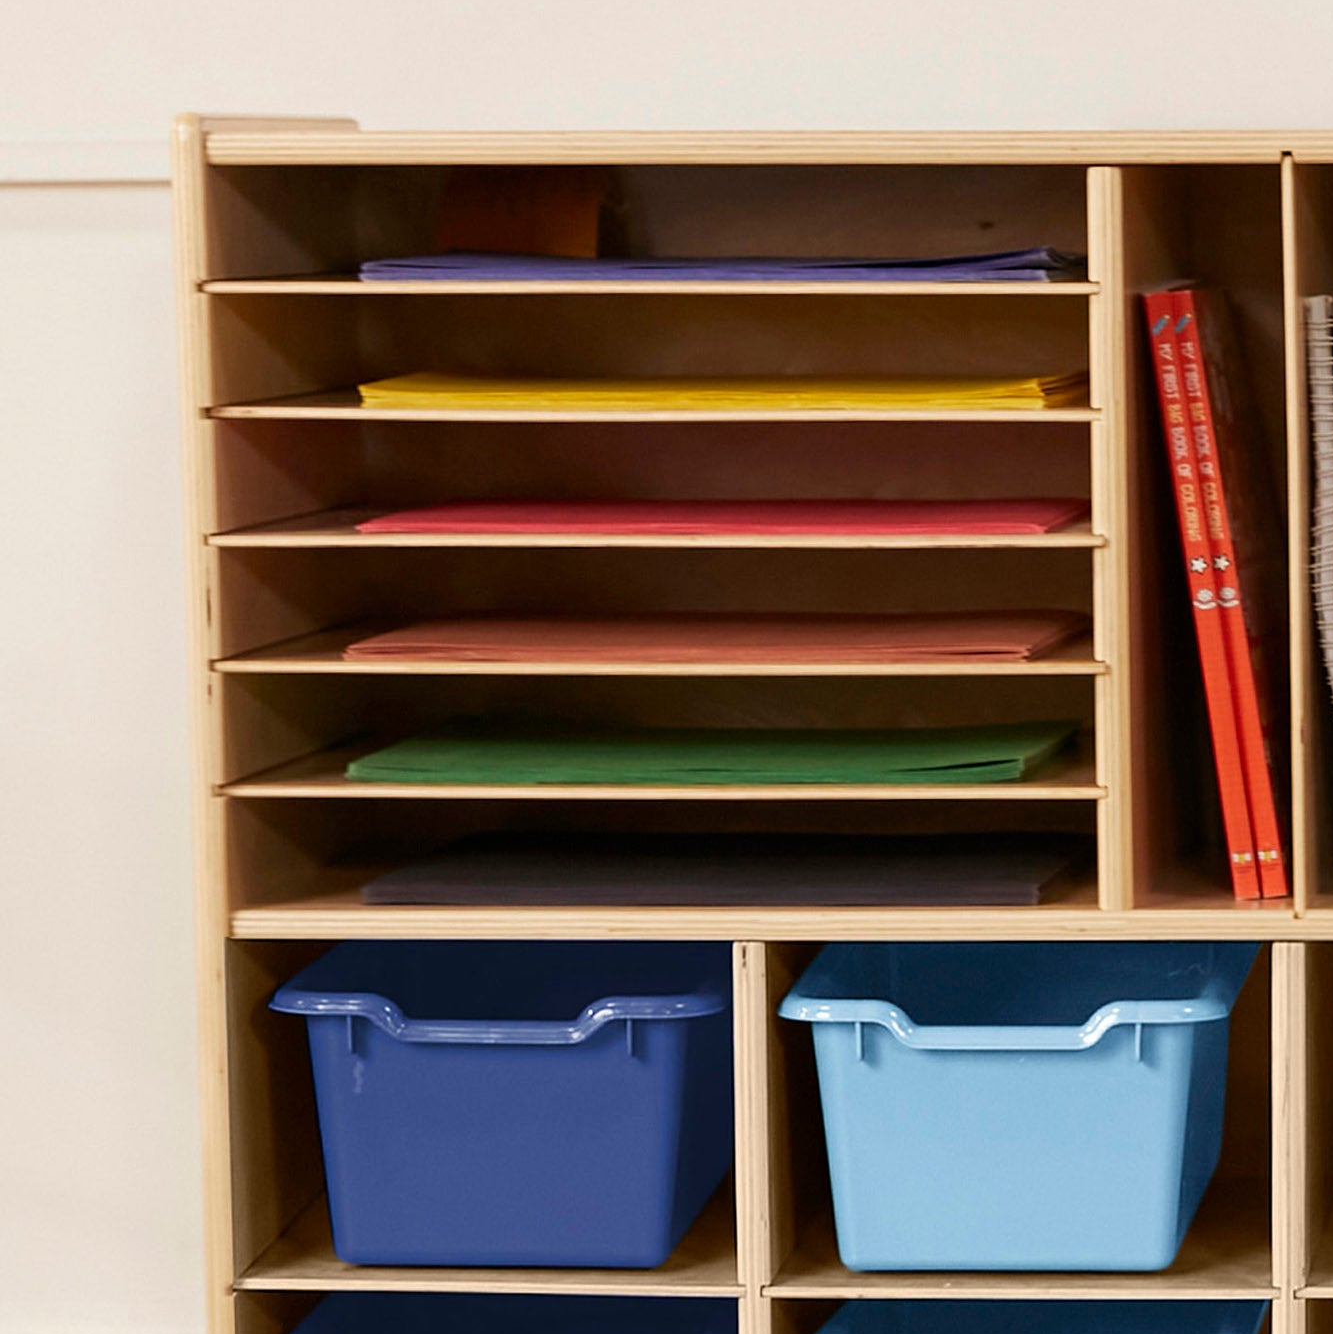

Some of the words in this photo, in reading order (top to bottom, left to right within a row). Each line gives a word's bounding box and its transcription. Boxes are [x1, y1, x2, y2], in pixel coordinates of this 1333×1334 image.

[1159, 343, 1173, 361] MY
[1181, 342, 1195, 359] MY
[1162, 365, 1179, 400] FIRST
[1185, 363, 1201, 399] FIRST
[1168, 404, 1183, 424] BIG
[1191, 402, 1205, 422] BIG
[1172, 426, 1189, 460] BOOK
[1195, 425, 1211, 458] BOOK
[1177, 464, 1192, 481] OF
[1200, 462, 1214, 478] OF
[1180, 483, 1201, 542] COLORING
[1204, 481, 1224, 540] COLORING
